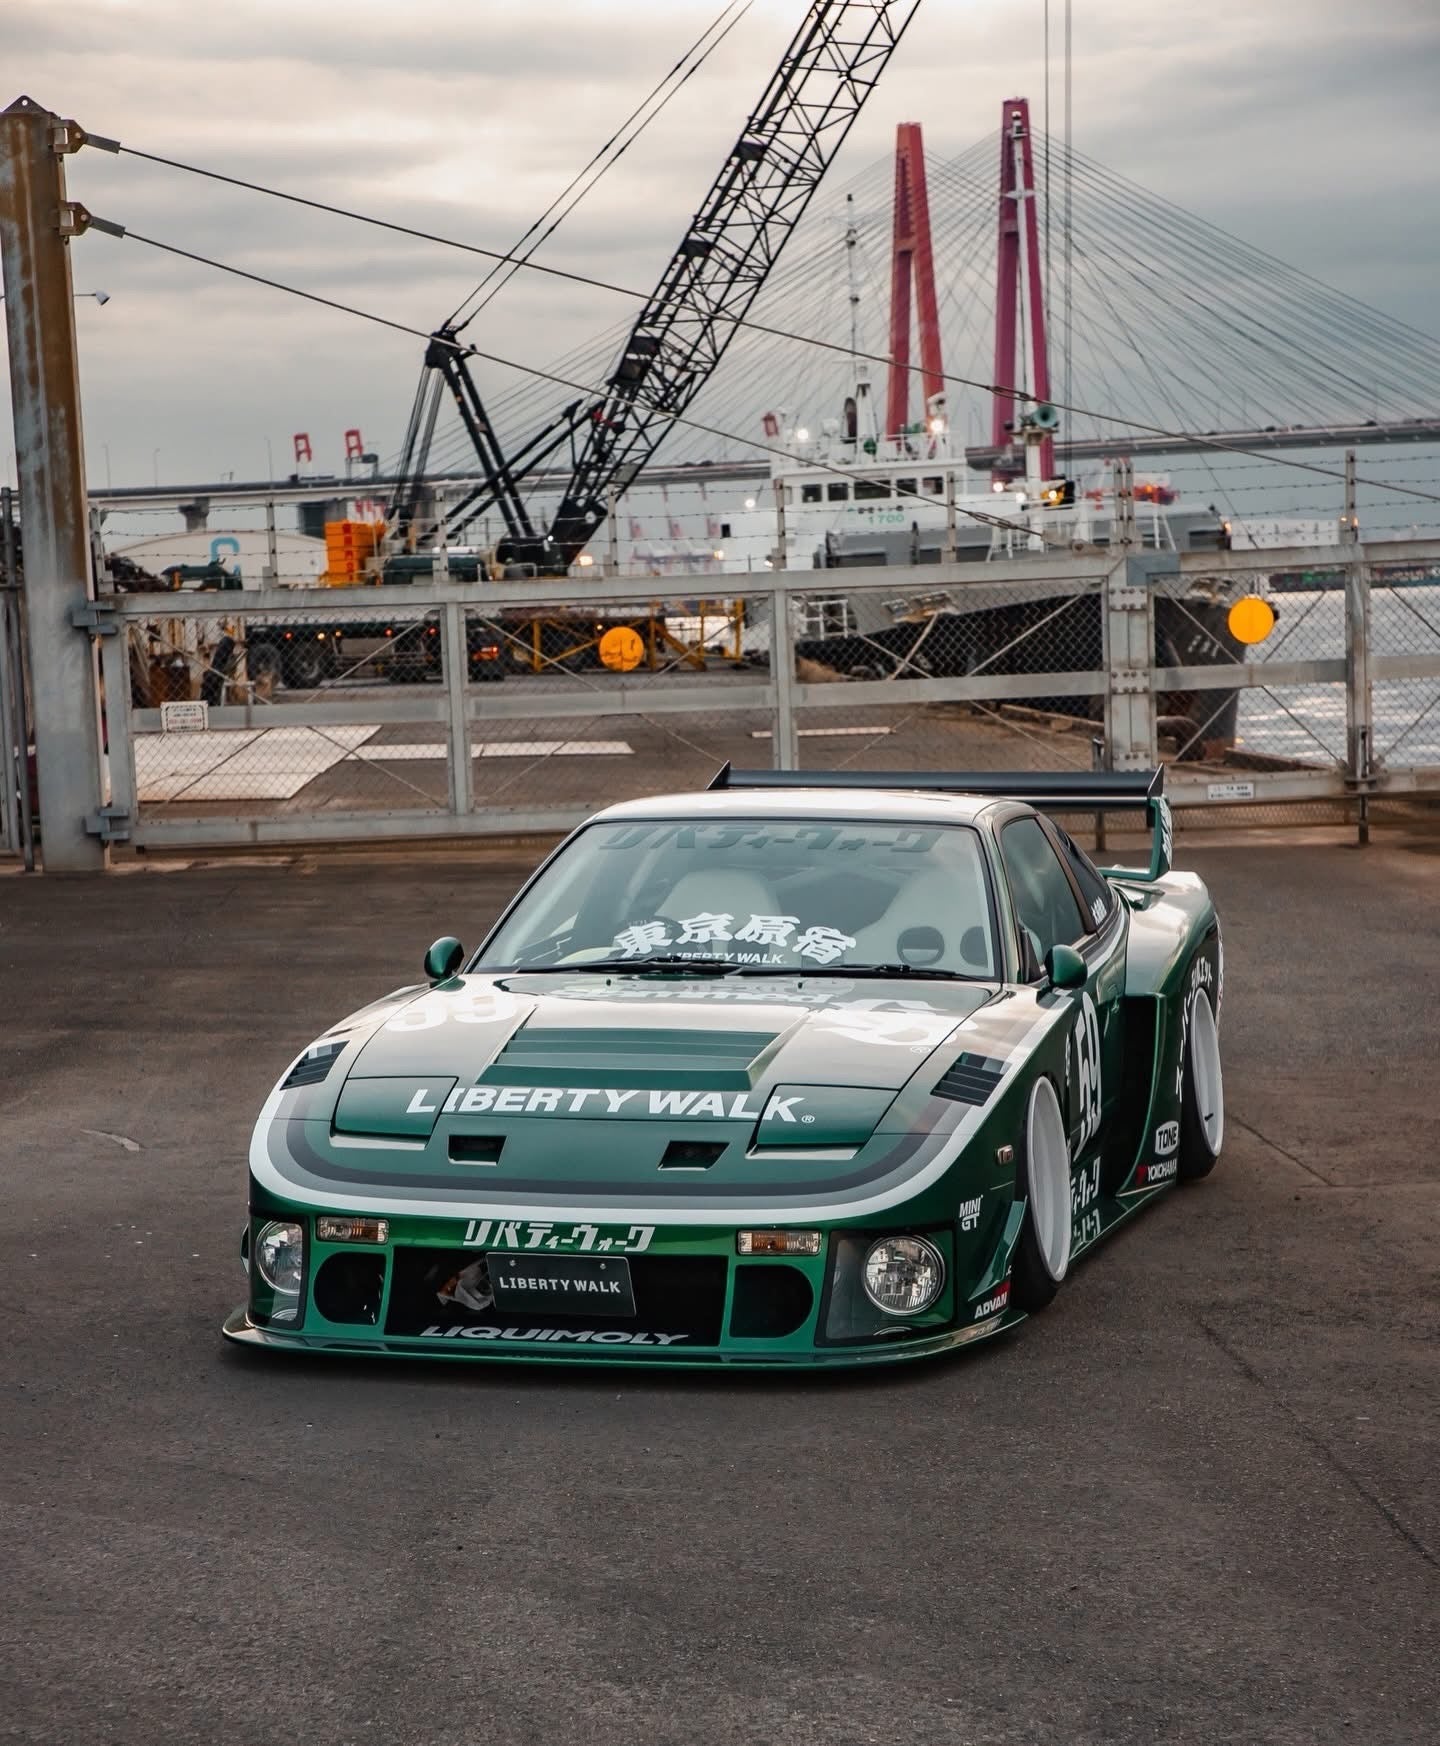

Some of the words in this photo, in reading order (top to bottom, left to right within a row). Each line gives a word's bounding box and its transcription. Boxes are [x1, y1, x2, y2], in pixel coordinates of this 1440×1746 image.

[735, 952, 783, 964] WALK
[1073, 991, 1102, 1162] 59
[406, 1086, 626, 1114] LIBERTY
[1158, 1126, 1178, 1151] TONE
[1147, 1158, 1178, 1181] YOKOHAMA
[960, 1197, 982, 1218] MINI
[961, 1212, 980, 1231] GT
[463, 1220, 655, 1252] リバティーウォーク
[500, 1277, 570, 1291] LIBERTY
[573, 1279, 621, 1293] WALK
[974, 1291, 1008, 1319] ADVAN
